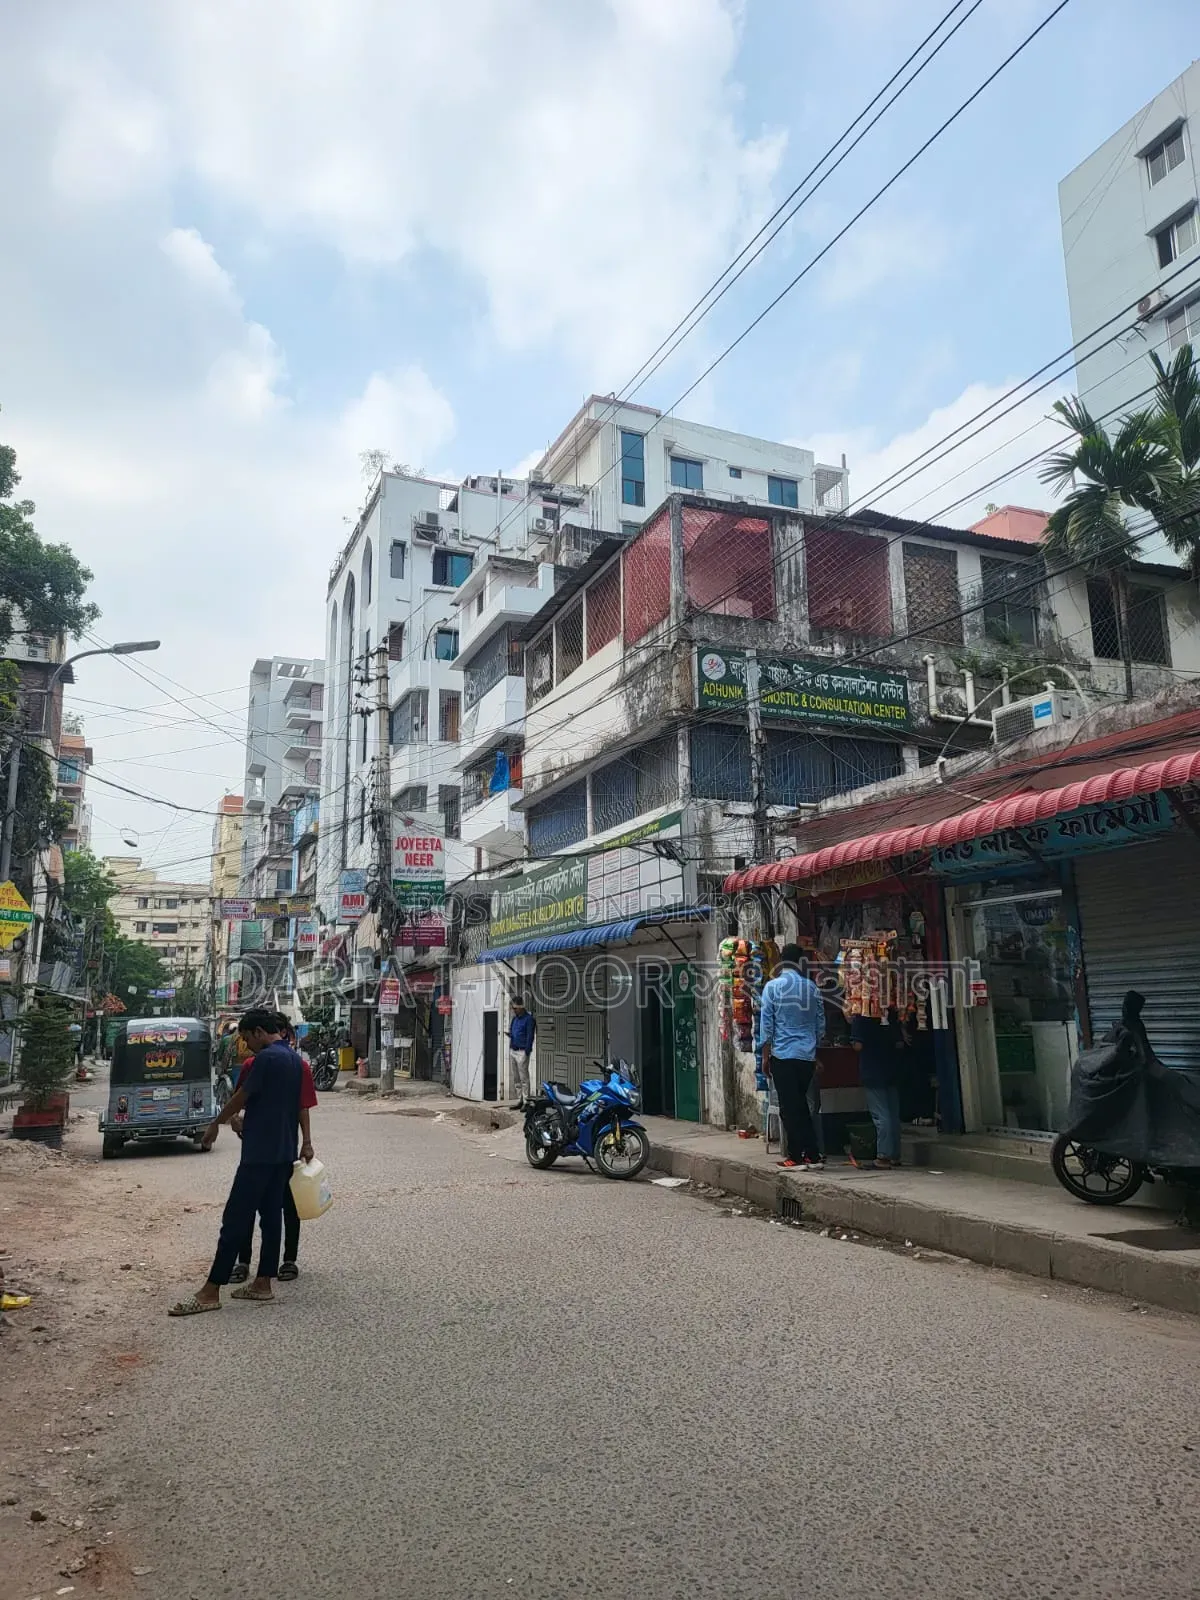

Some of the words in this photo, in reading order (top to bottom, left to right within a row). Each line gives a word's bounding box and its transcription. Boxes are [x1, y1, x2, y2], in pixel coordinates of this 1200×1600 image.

[880, 679, 904, 701] সেন্টার
[703, 682, 744, 699] ADHUNIK
[760, 690, 800, 707] GNOSTIC
[801, 694, 807, 708] &
[809, 695, 872, 715] CONSULTATION
[874, 703, 906, 720] CENTER
[395, 837, 443, 852] JOYEETA
[405, 853, 434, 867] NEER
[342, 894, 365, 906] AMI
[300, 933, 316, 943] AMI
